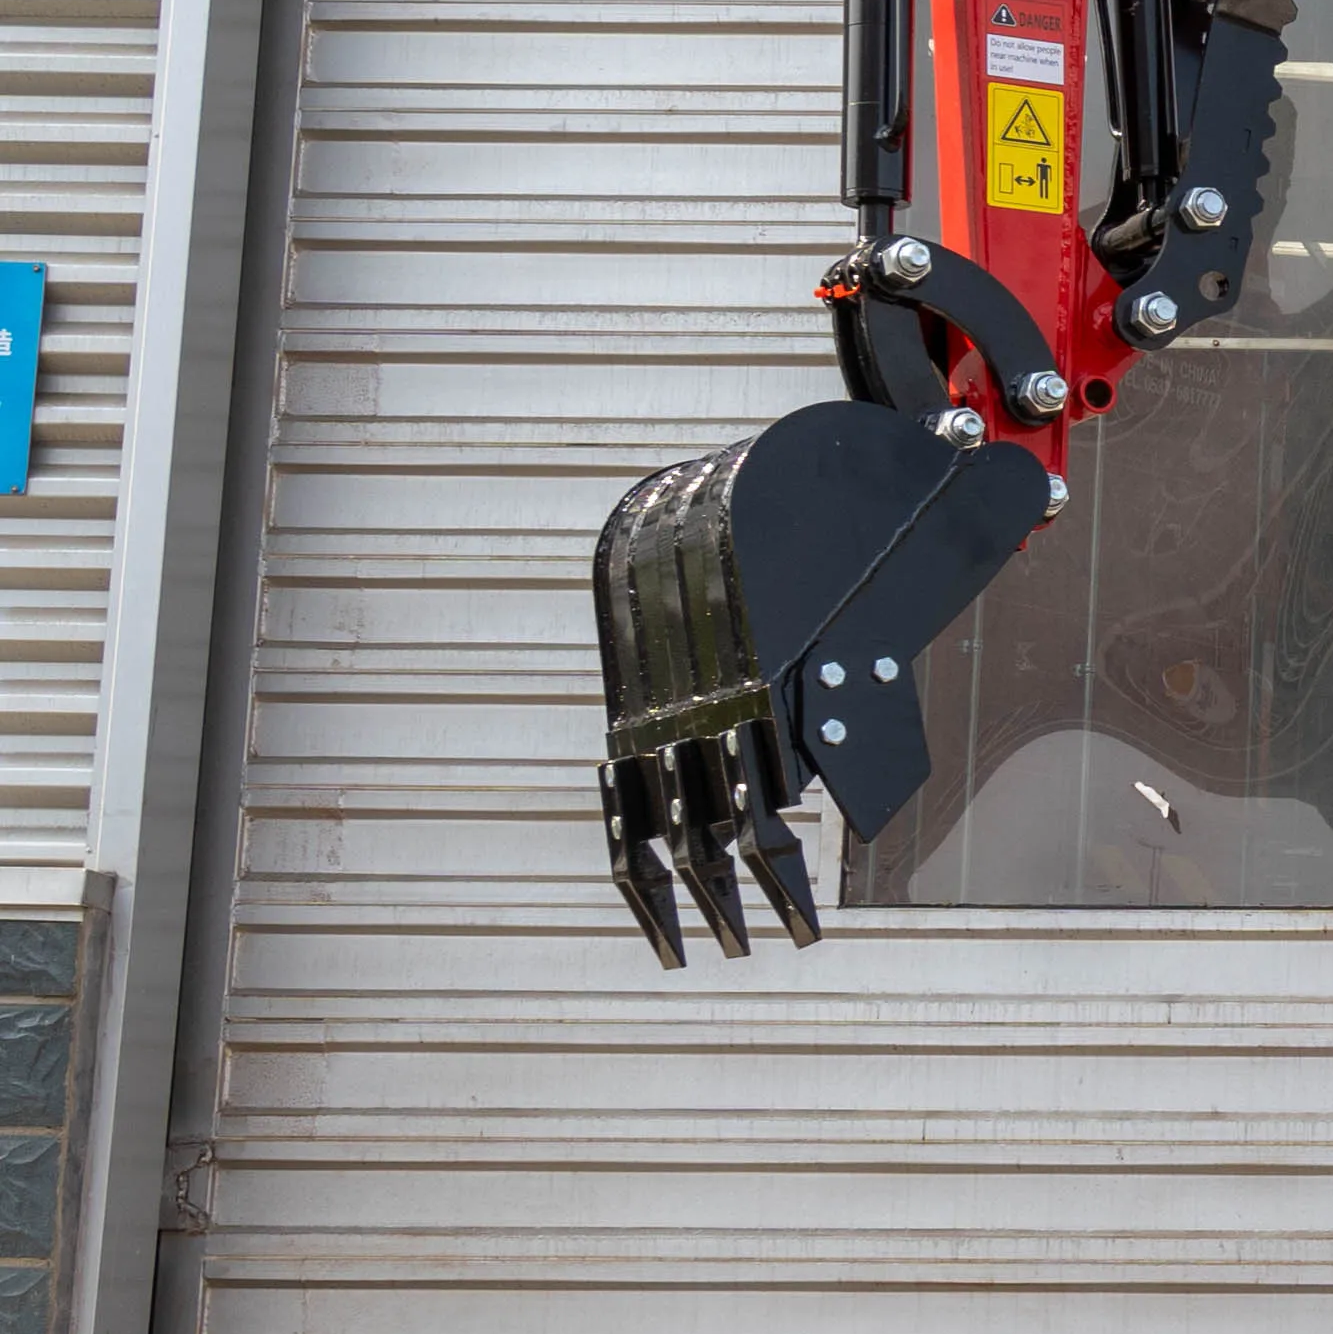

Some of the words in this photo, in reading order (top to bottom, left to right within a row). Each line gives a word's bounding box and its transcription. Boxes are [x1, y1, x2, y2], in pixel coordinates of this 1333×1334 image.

[1019, 12, 1062, 31] DANGER
[990, 37, 1002, 47] Do
[1017, 41, 1035, 51] allow
[1036, 46, 1062, 56] people
[990, 52, 1006, 60] near
[1007, 54, 1037, 64] machine
[1039, 58, 1060, 67] when
